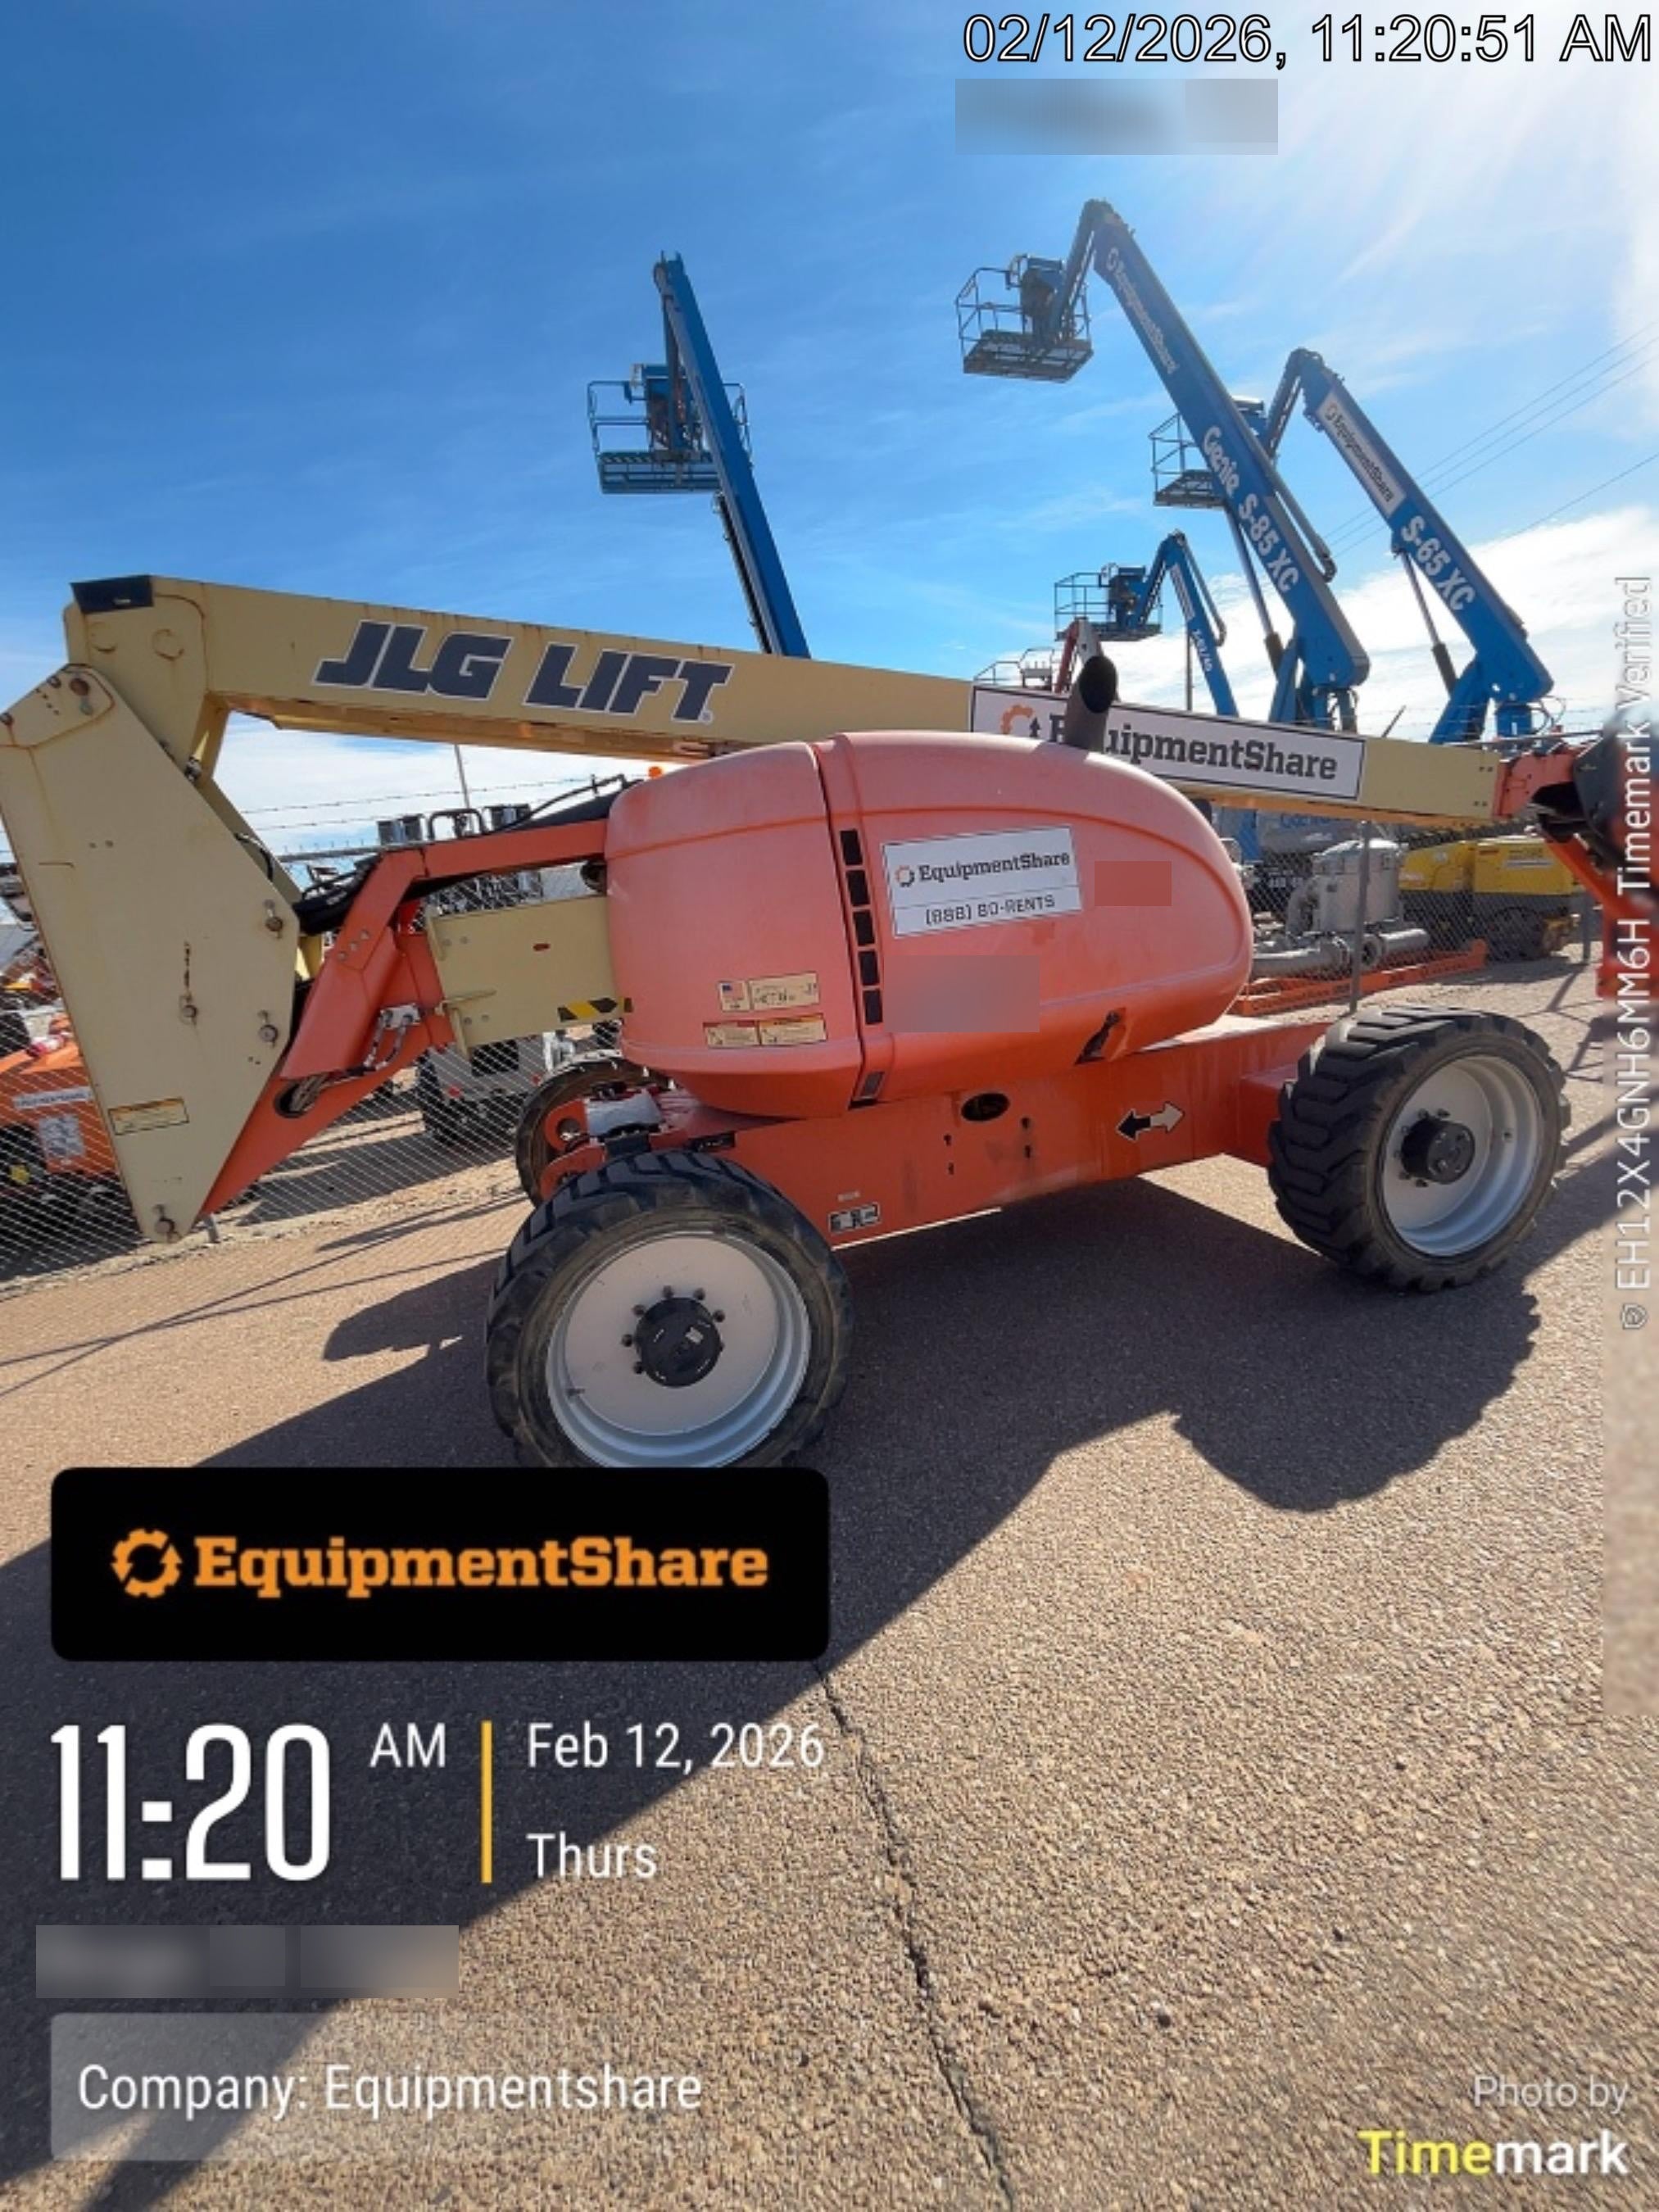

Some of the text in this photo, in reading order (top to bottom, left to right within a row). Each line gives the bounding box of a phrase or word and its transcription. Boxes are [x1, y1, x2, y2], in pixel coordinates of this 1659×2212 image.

[1204, 426, 1299, 592] Genie S-85 XC
[1401, 516, 1474, 610] S-65 XC
[312, 619, 514, 700] JLG
[918, 852, 1070, 882] EquipmentShare
